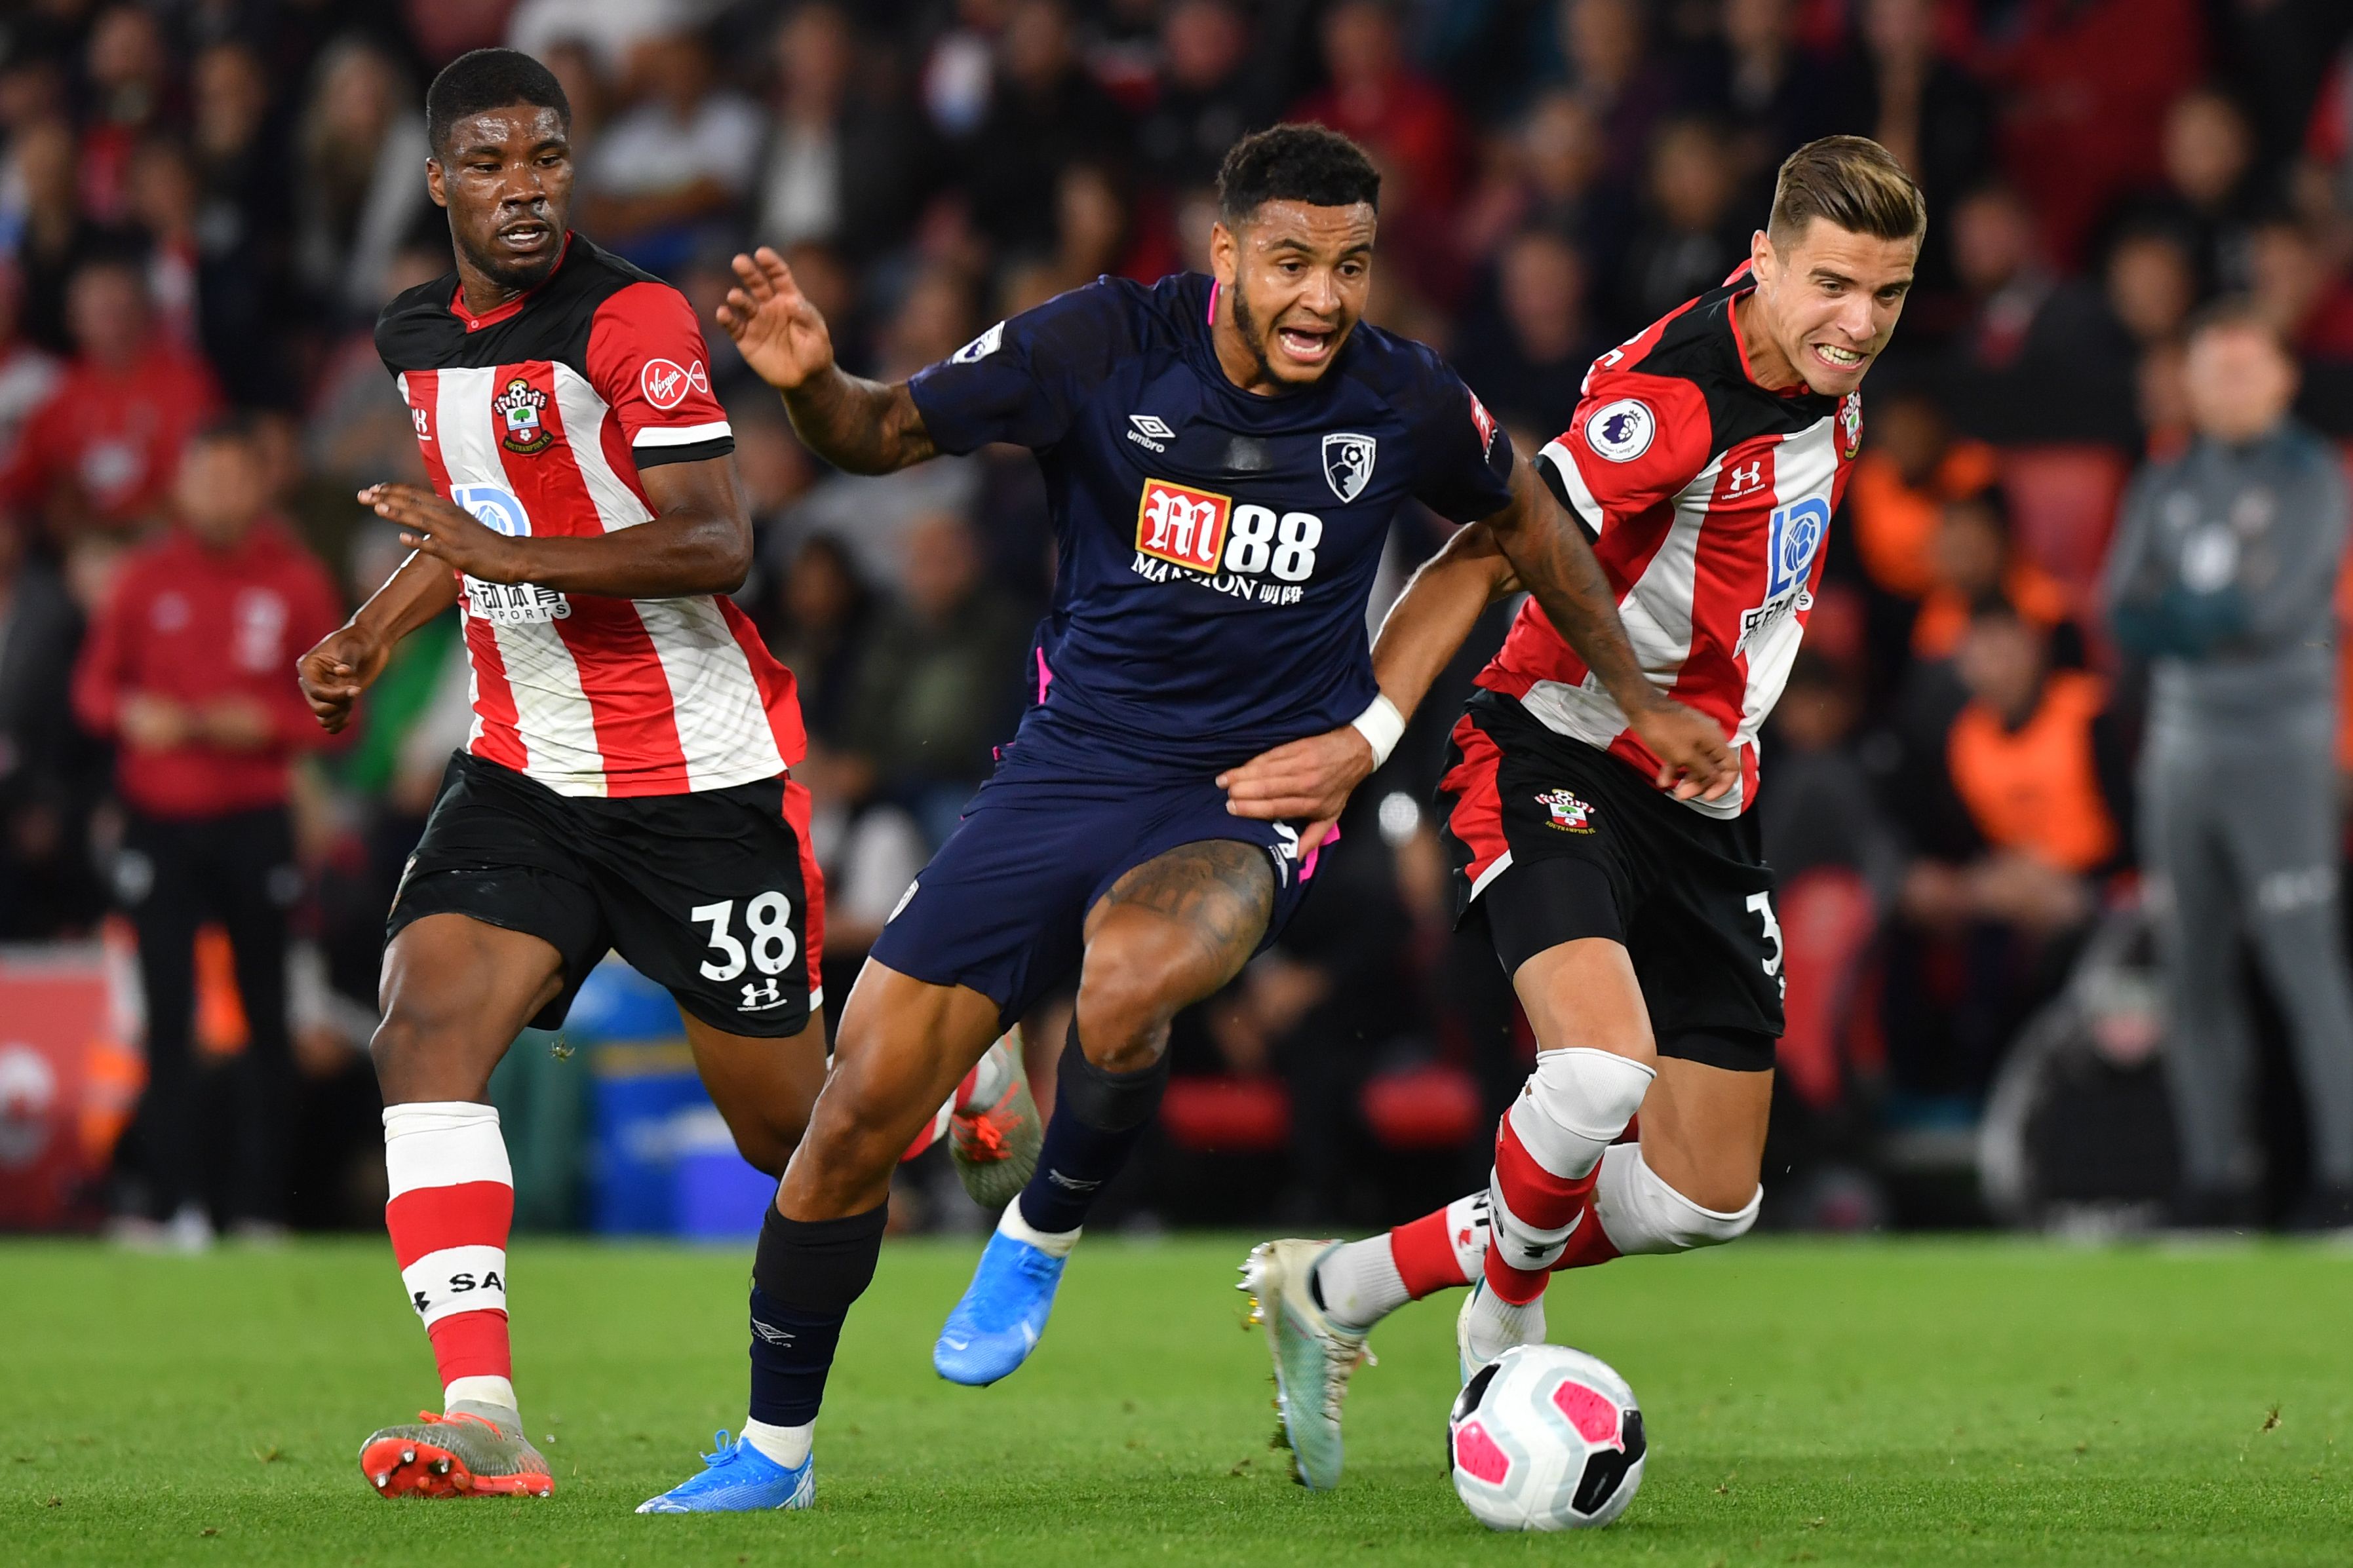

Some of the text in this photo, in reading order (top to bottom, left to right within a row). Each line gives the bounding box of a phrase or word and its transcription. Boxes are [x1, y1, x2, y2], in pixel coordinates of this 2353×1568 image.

[650, 368, 682, 400] Virgin
[1127, 429, 1165, 453] umbro
[488, 603, 567, 620] SPORTS
[1546, 820, 1589, 835] SOUTHAMPTON
[690, 890, 798, 982] 38
